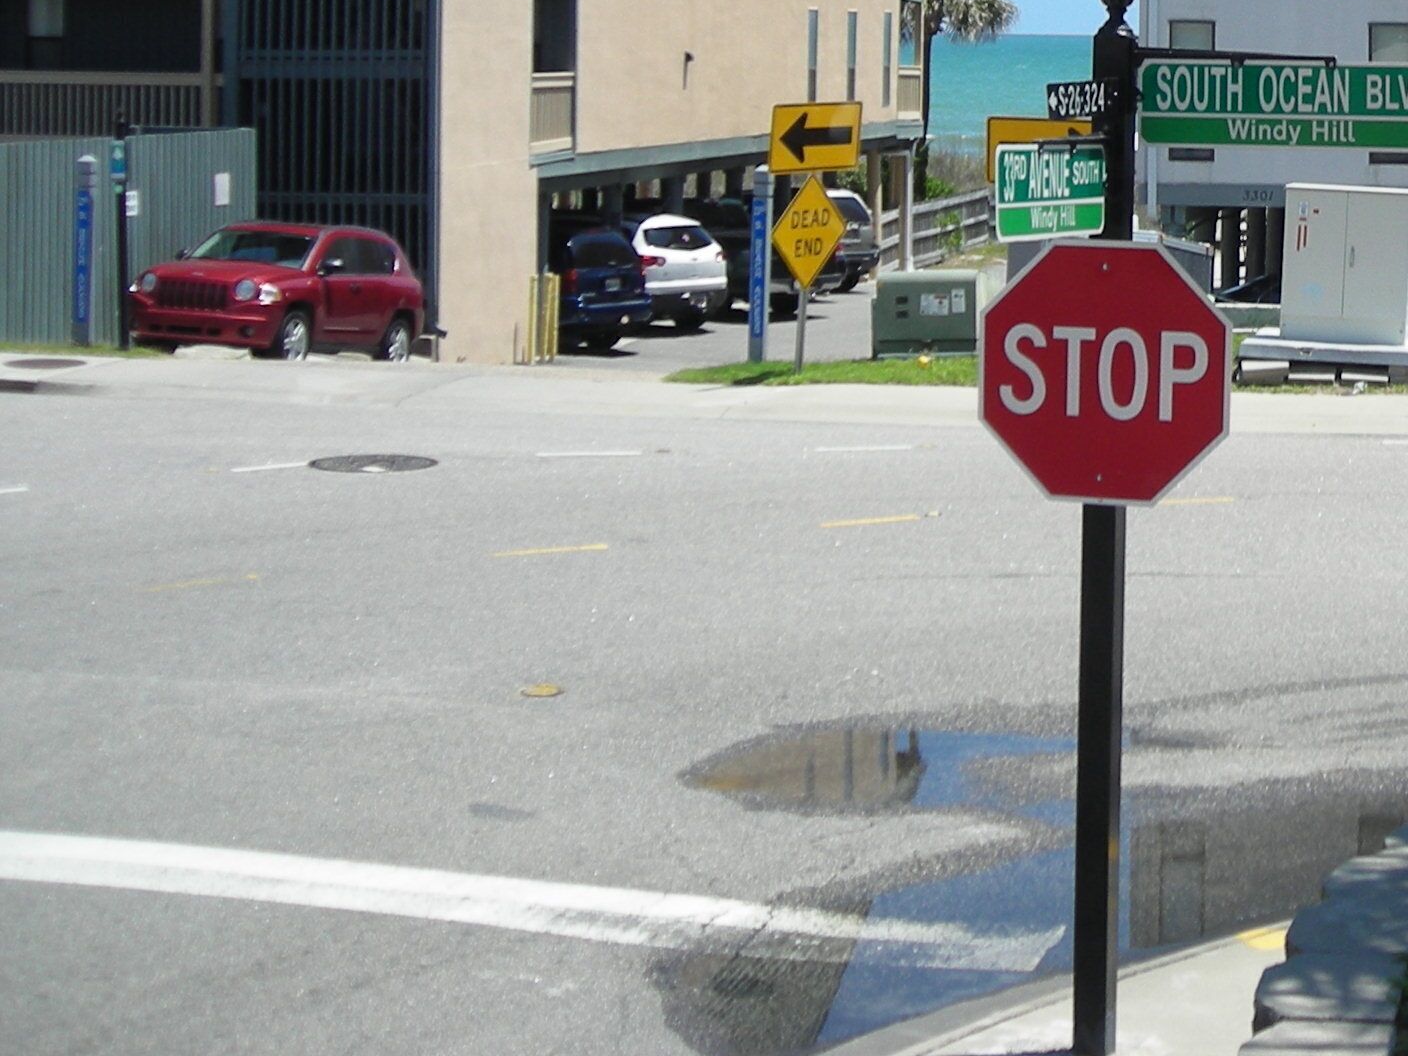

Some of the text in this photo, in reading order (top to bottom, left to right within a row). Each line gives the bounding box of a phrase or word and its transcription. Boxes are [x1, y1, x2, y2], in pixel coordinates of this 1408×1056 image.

[1156, 64, 1244, 113] SOUTH
[1258, 66, 1351, 114] OCEAN
[1226, 118, 1356, 145] Windy Hill
[1003, 151, 1100, 202] 33RD AVENUE SOUTH
[1242, 190, 1274, 202] 3301
[790, 208, 831, 230] DEAD
[1030, 206, 1076, 231] Windy Hill
[794, 237, 823, 258] END
[998, 322, 1209, 423] STOP
